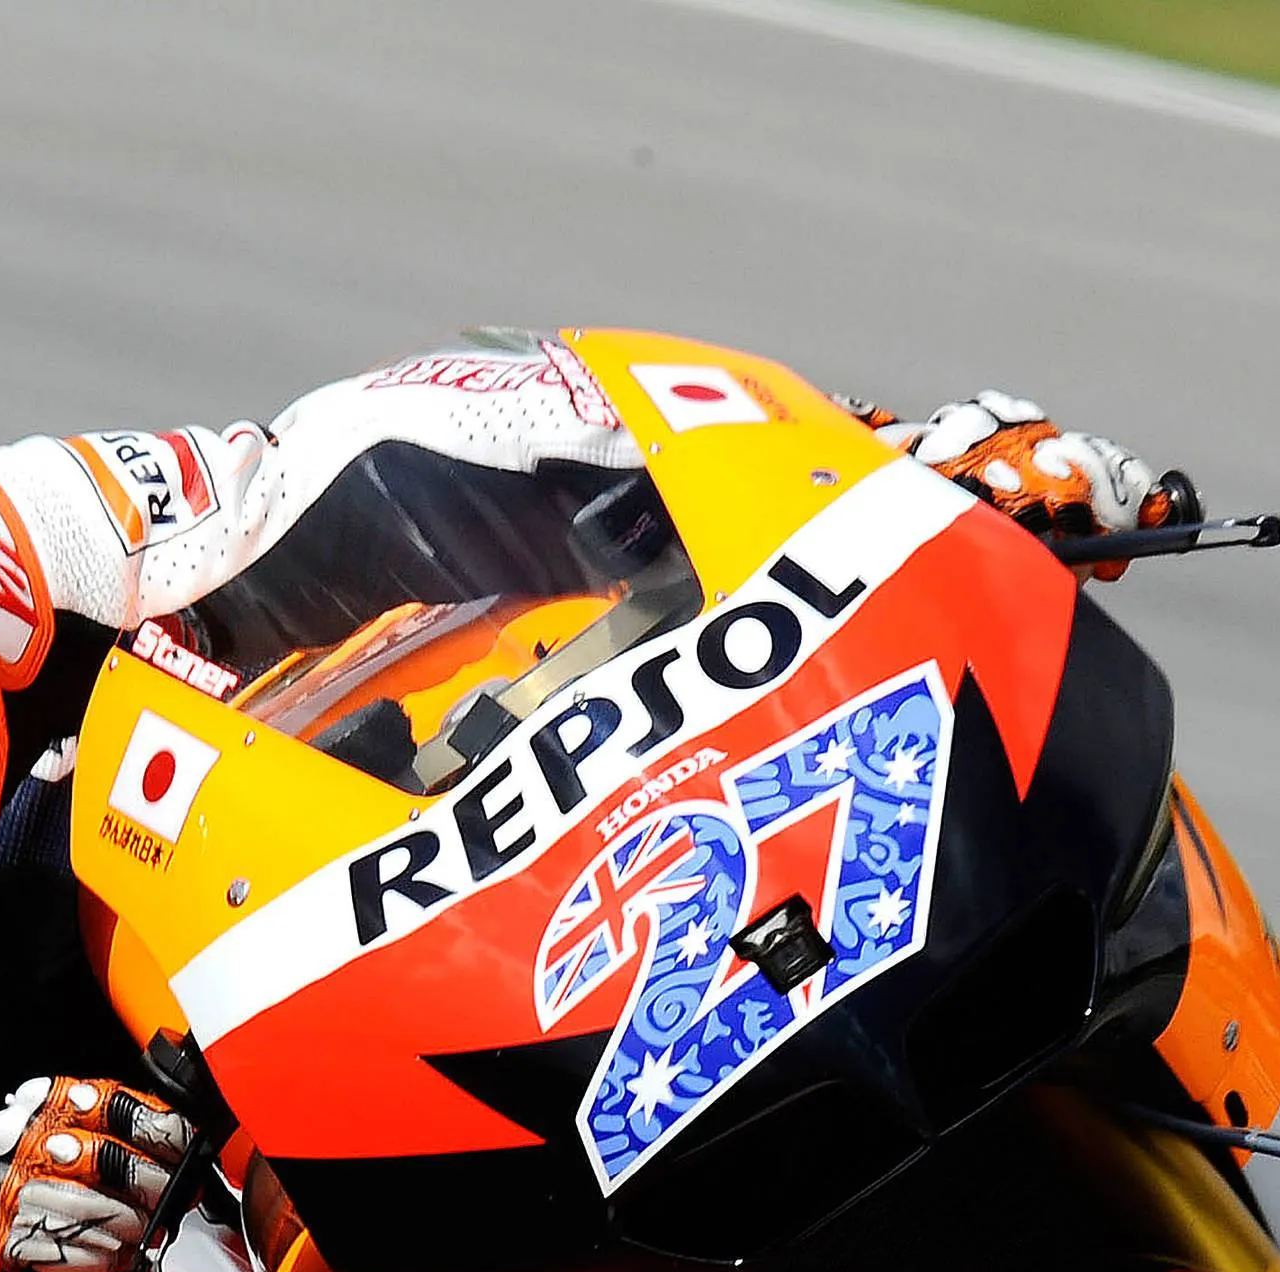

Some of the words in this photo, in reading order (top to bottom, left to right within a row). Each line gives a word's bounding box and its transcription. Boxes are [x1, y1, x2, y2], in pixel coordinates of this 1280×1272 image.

[131, 619, 241, 703] Stoner
[348, 553, 867, 946] REPSOL
[597, 747, 728, 841] HONDA
[535, 659, 954, 1198] 27
